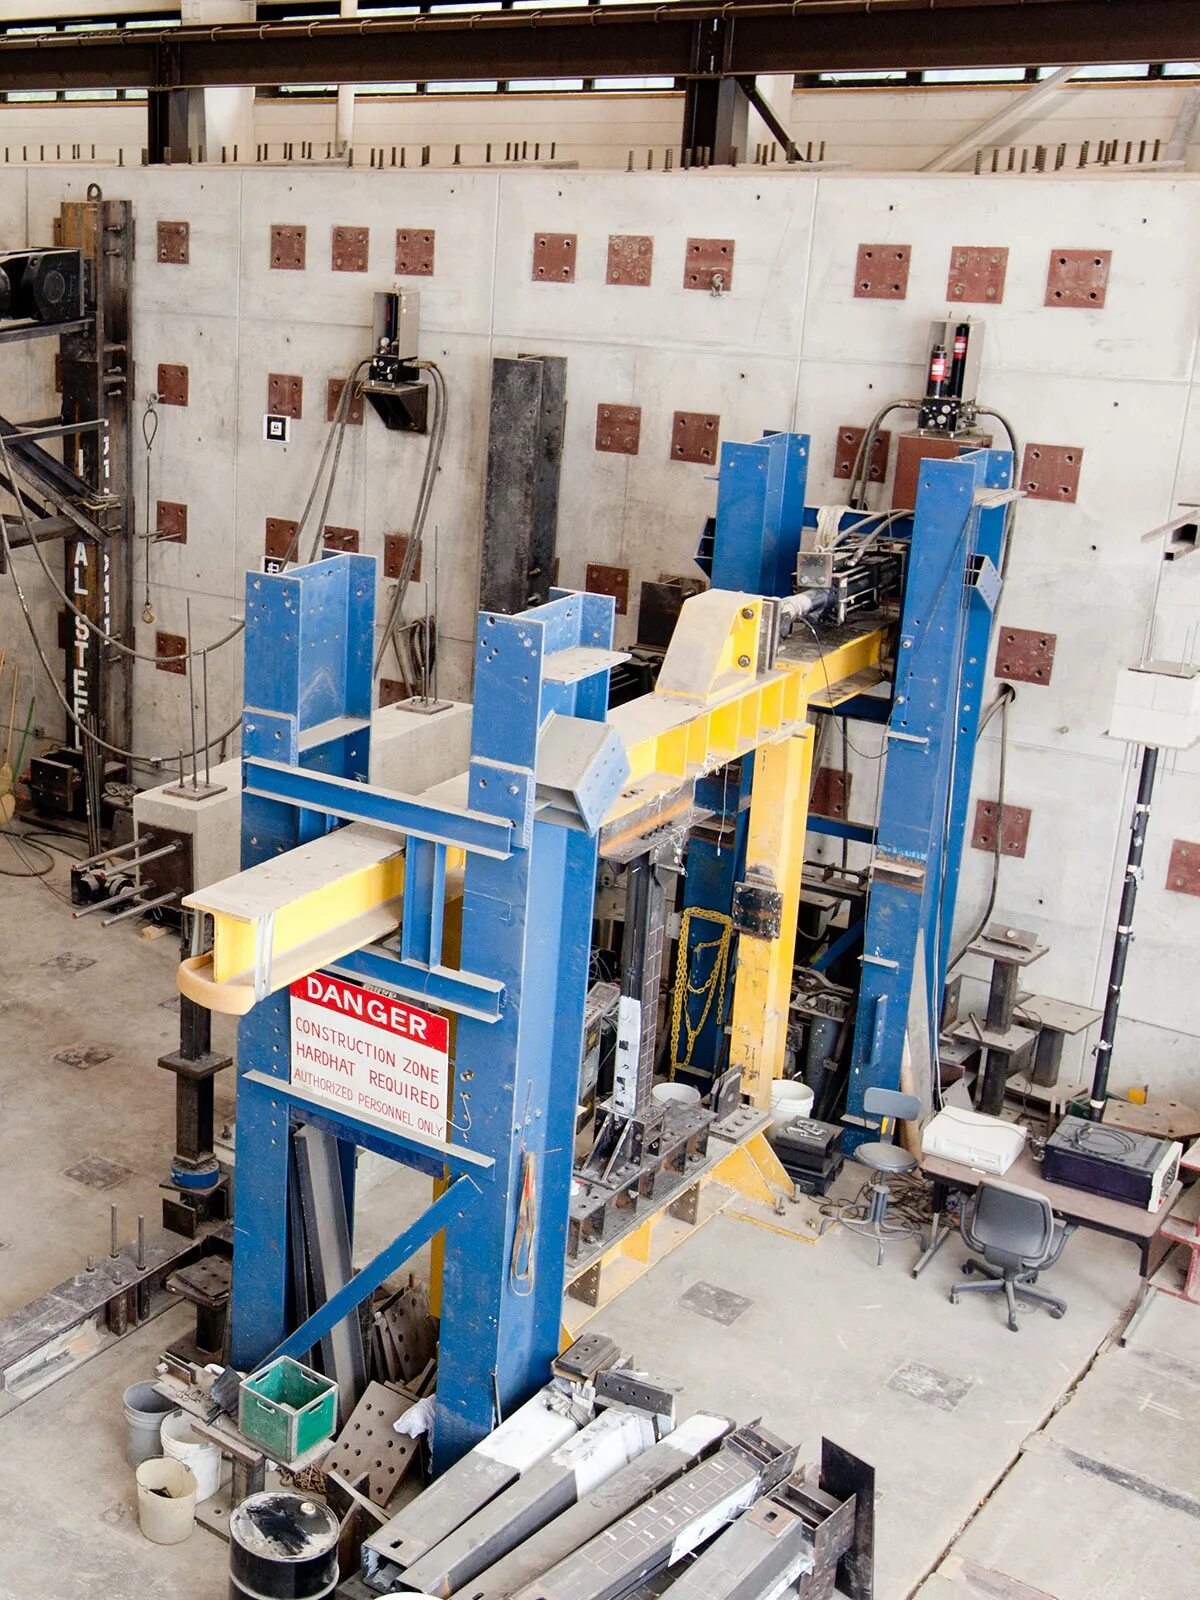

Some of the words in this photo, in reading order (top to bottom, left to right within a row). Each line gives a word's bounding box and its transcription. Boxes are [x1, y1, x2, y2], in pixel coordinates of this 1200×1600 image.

[73, 614, 89, 751] STEEL
[307, 976, 427, 1040] DANGER
[296, 1017, 396, 1067] CONSTRUCTION
[402, 1057, 440, 1085] ZONE
[296, 1042, 356, 1077] HARDHAT
[369, 1070, 440, 1110] REQUIRED
[294, 1068, 353, 1101] AUTHORIZED
[358, 1093, 413, 1126] PERSONNEL
[417, 1118, 444, 1137] ONLY
